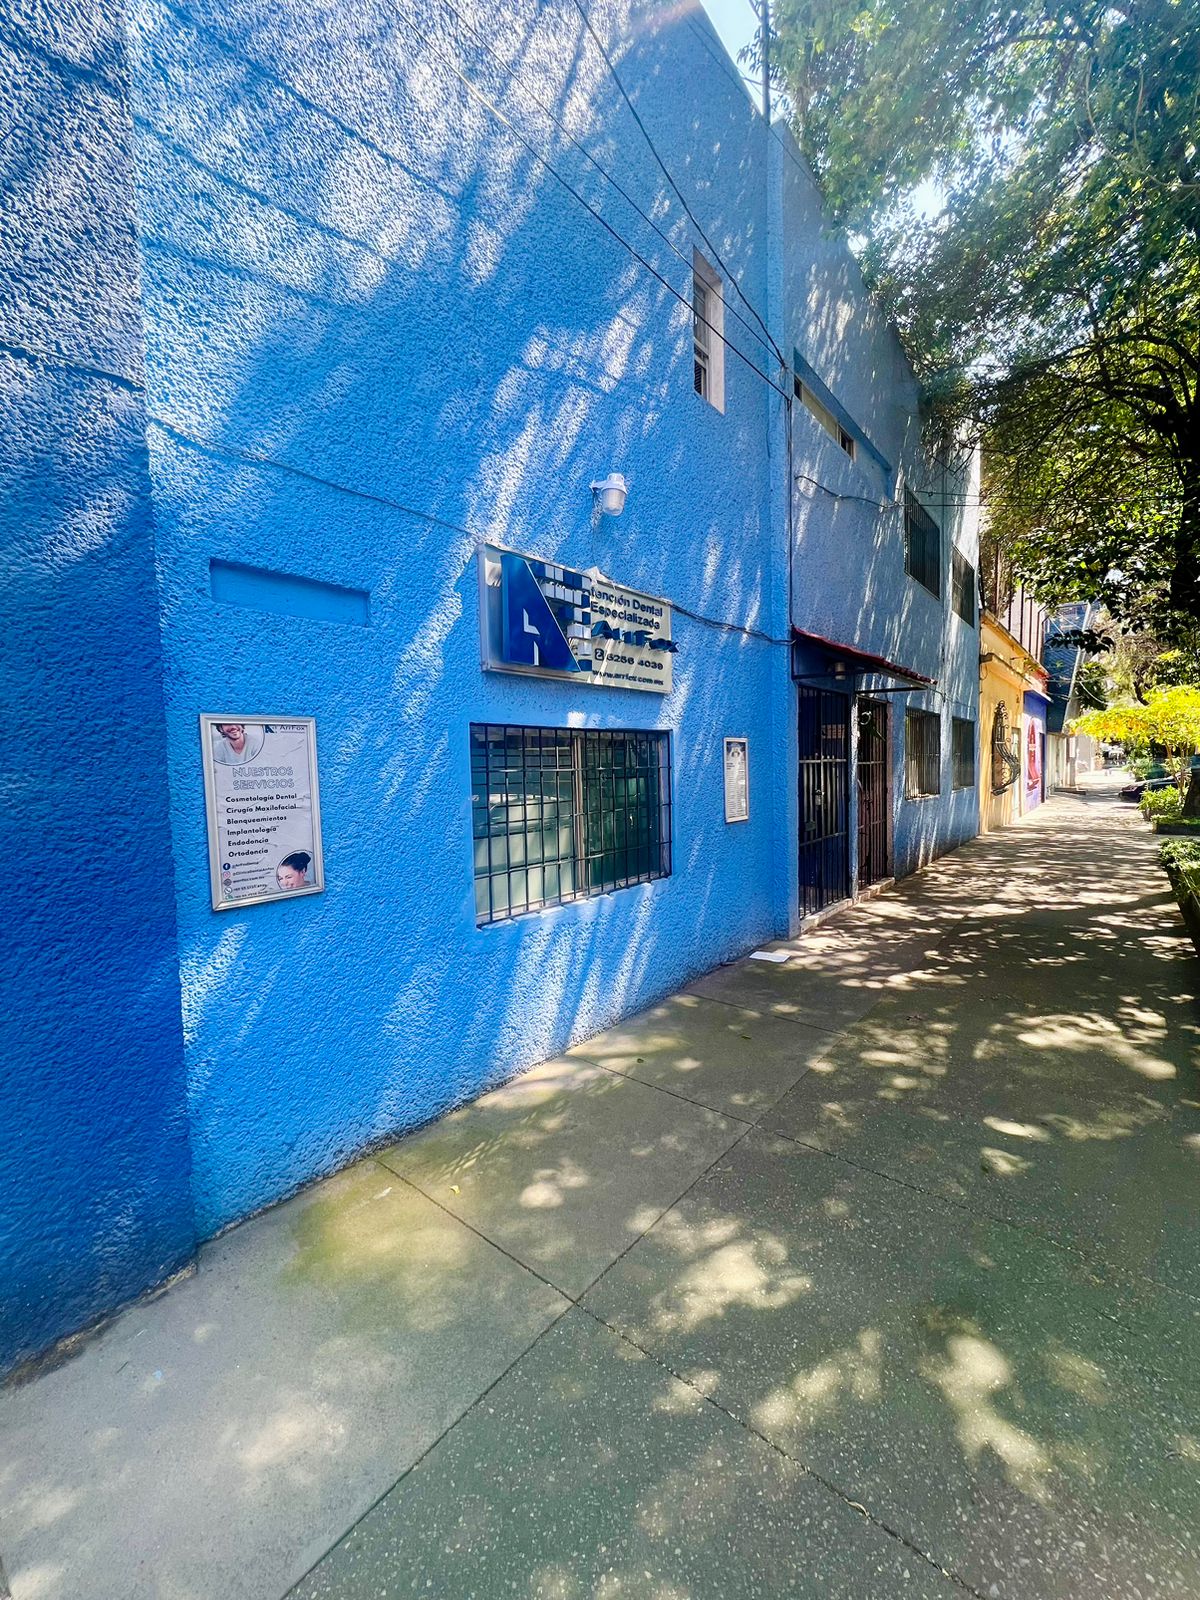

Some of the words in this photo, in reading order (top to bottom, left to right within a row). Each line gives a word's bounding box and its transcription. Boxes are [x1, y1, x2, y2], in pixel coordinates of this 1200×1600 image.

[590, 586, 630, 608] tención
[632, 599, 663, 617] Dental
[590, 600, 661, 630] Especializada
[232, 766, 294, 778] NUESTROS
[232, 778, 295, 791] SERVICIOS
[225, 794, 274, 803] Cosmetología
[226, 806, 253, 814] Cirugía
[254, 803, 297, 812] Maxilofacial
[226, 815, 287, 825] Blanqueamientos
[227, 826, 277, 836] Implantología
[228, 837, 269, 847] Endodoncia
[228, 848, 269, 858] Ortodoncia
